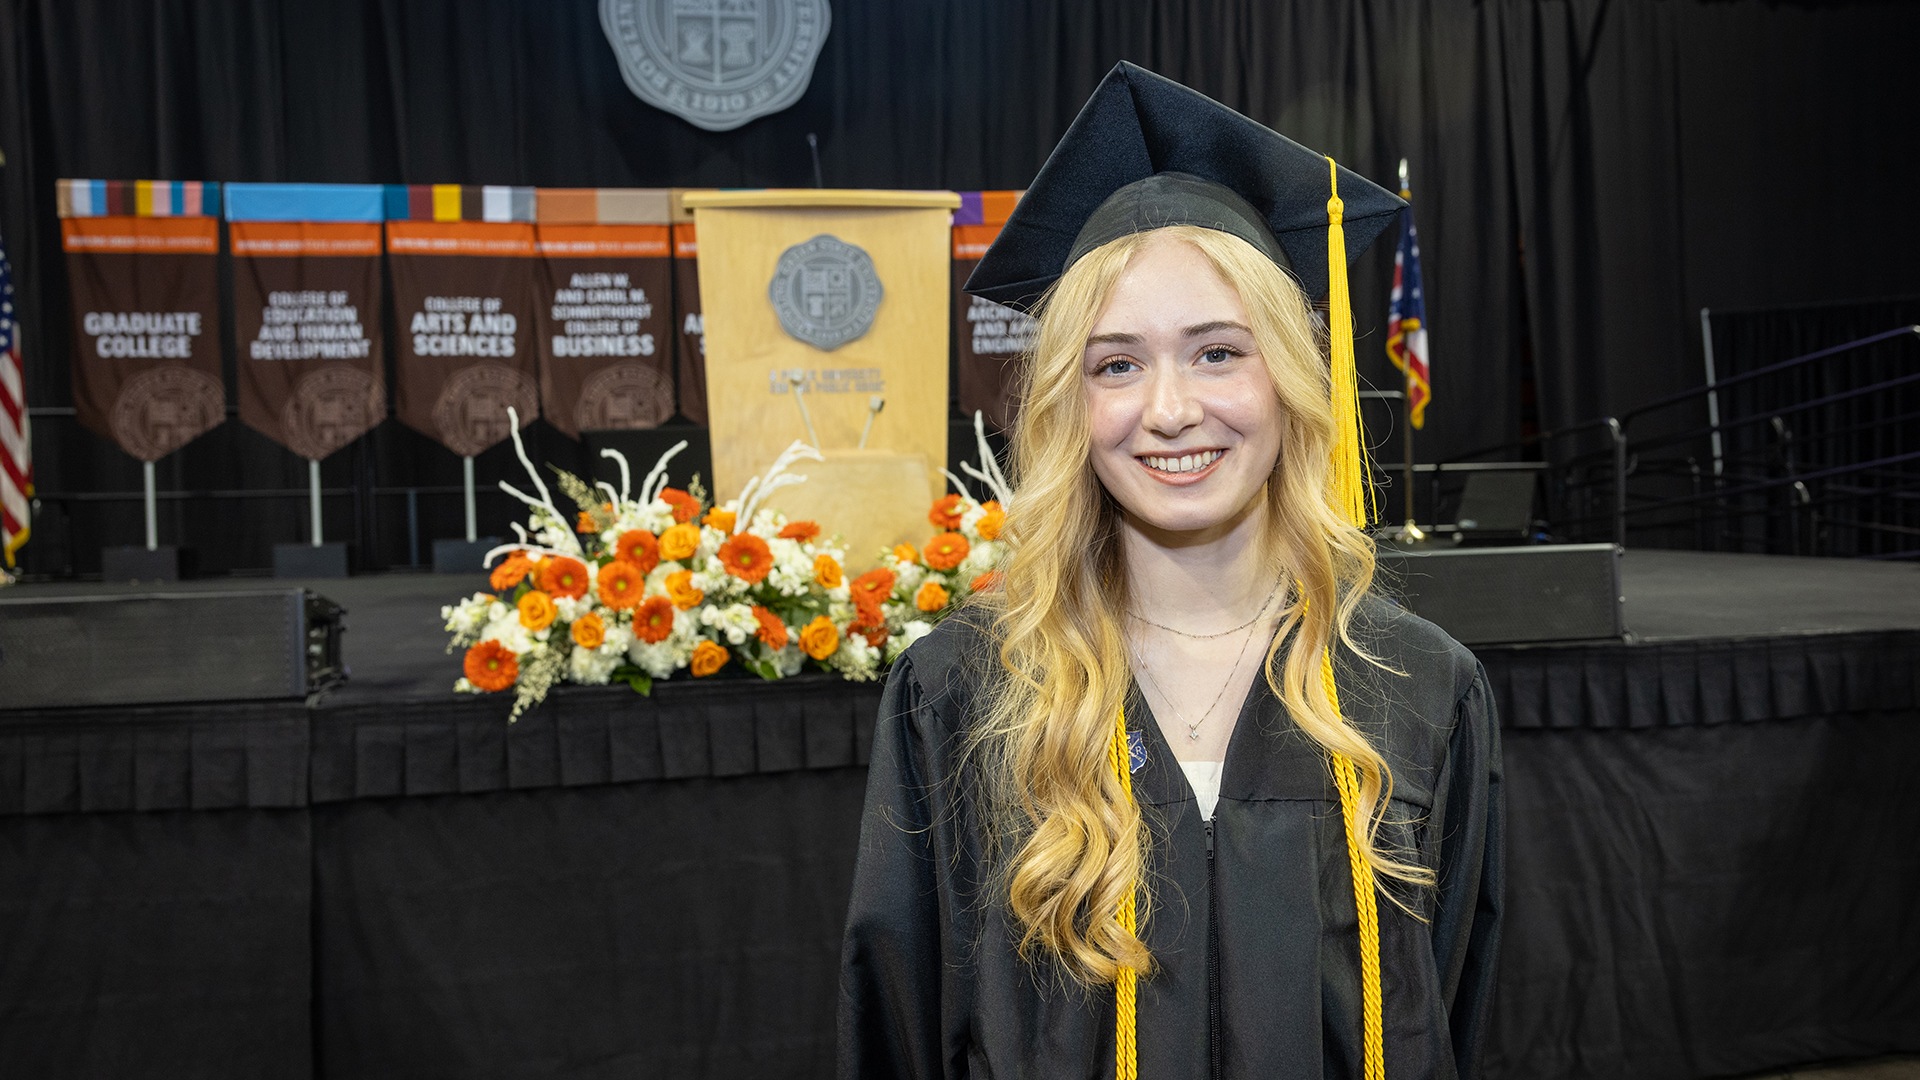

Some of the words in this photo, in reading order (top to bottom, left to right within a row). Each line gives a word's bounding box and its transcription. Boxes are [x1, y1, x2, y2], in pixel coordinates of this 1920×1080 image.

[570, 272, 611, 289] ALLEN
[268, 291, 327, 306] COLLEGE
[328, 290, 349, 305] OF
[424, 296, 481, 312] COLLEGE
[483, 297, 502, 313] OF
[554, 288, 585, 304] AND
[586, 288, 628, 304] CAROL
[84, 312, 201, 335] GRADUATE
[263, 306, 357, 324] EDUCATION
[410, 312, 466, 334] ARTS
[468, 312, 517, 336] AND
[258, 324, 296, 342] AND
[298, 324, 363, 341] HUMAN
[564, 320, 620, 336] COLLEGE
[621, 320, 640, 335] OF
[972, 320, 1008, 337] AND
[97, 335, 192, 358] COLLEGE
[250, 339, 371, 360] DEVELOPMENT
[413, 334, 515, 357] SCIENCES
[552, 334, 655, 357] BUSINESS
